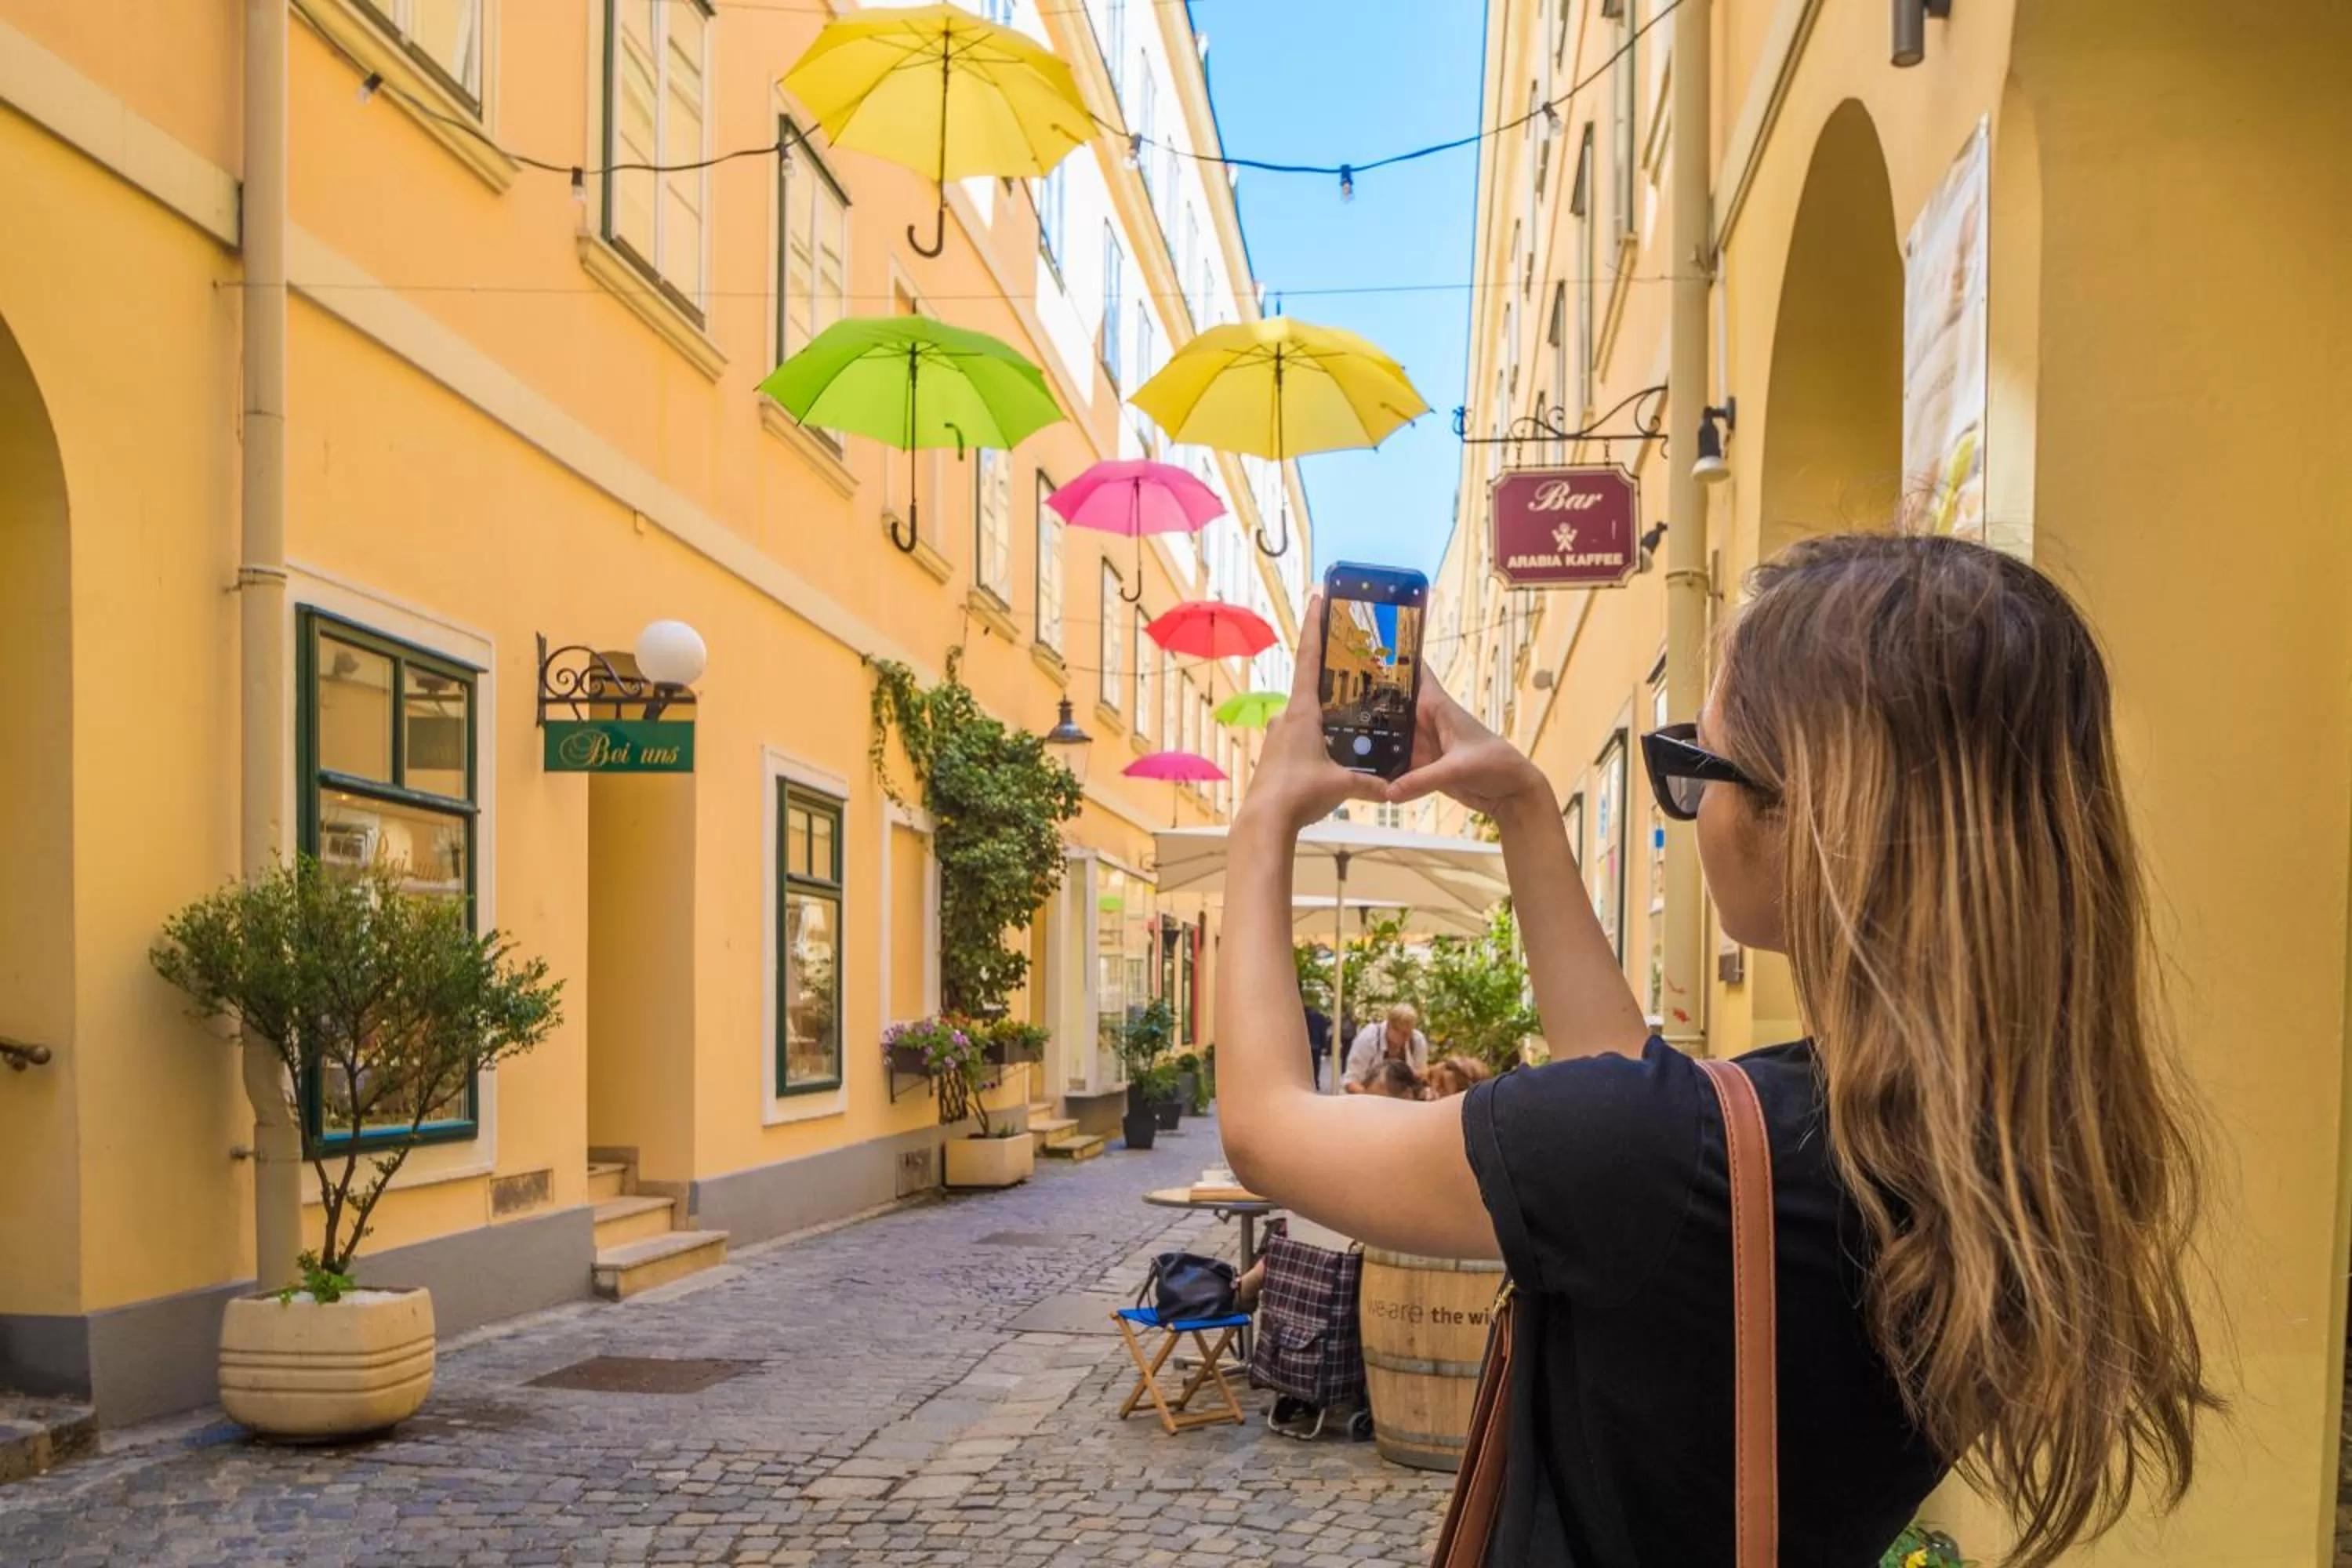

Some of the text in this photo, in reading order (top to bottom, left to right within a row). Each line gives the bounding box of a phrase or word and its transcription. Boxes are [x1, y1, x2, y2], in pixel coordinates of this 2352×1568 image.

[1527, 479, 1604, 512] Bar
[1507, 552, 1624, 568] ARABIA KAFFEE
[558, 728, 681, 768] Bei uns
[1431, 1305, 1464, 1324] the
[1467, 1306, 1490, 1325] wi
